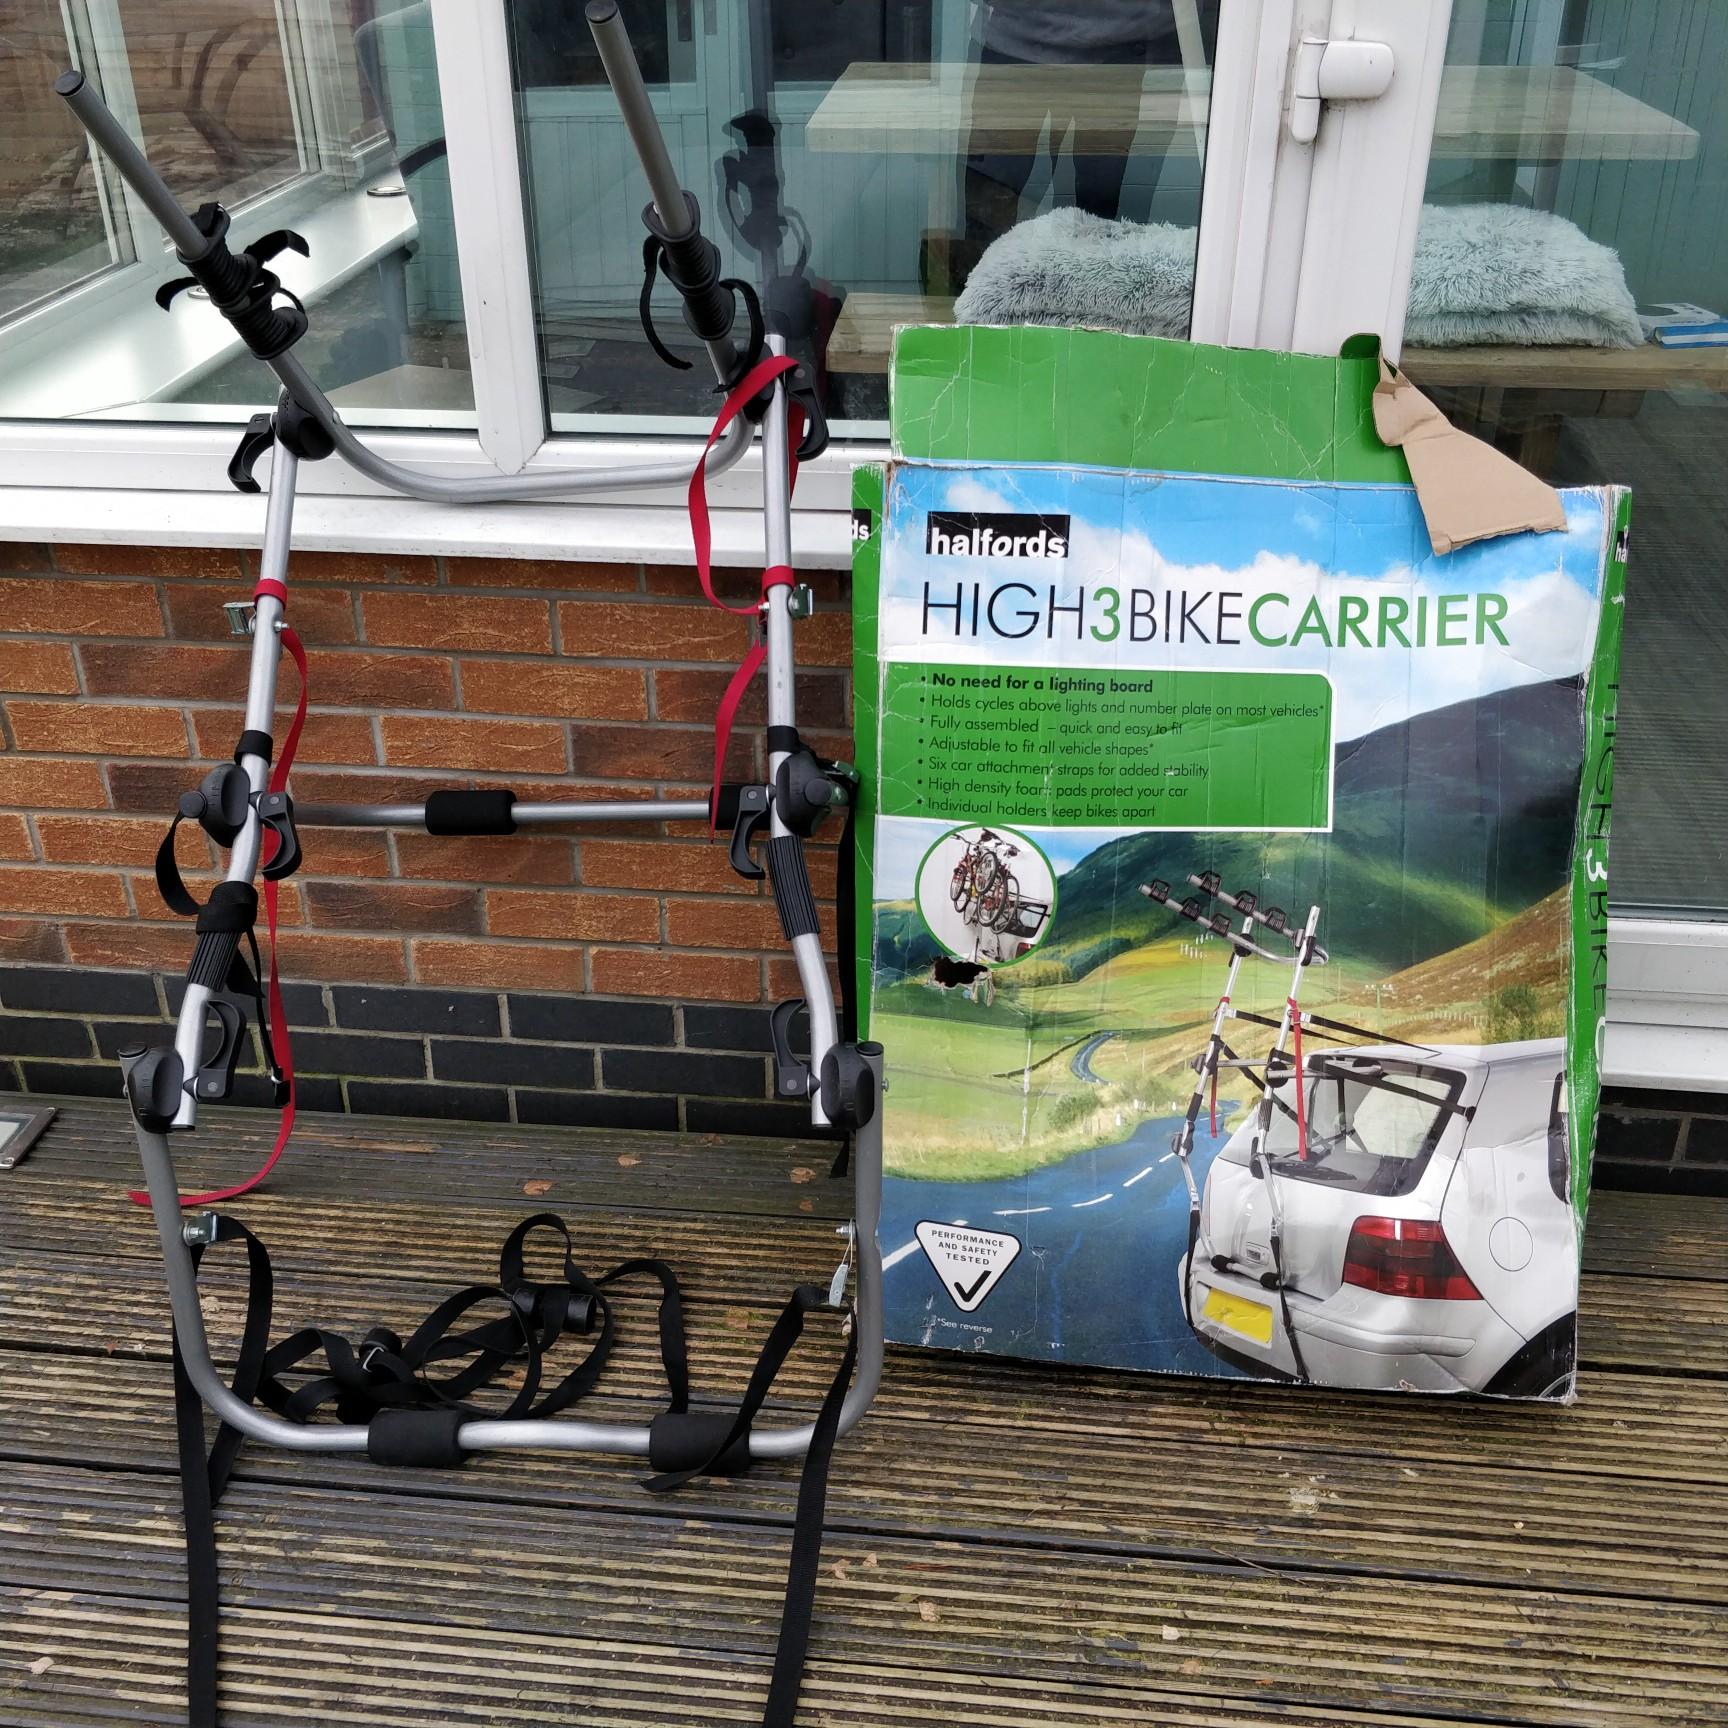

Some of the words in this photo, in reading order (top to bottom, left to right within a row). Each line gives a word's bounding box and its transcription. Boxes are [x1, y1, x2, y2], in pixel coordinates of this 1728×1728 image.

[931, 526, 1067, 558] halfords
[932, 673, 956, 687] No
[961, 675, 1001, 689] need
[1006, 675, 1028, 690] for
[1033, 679, 1044, 690] a
[1050, 676, 1105, 695] lighting
[1110, 678, 1153, 693] board
[931, 694, 970, 709] Holds
[975, 696, 1014, 712] cycles
[1019, 697, 1061, 712] above
[1065, 700, 1097, 715] lights
[1101, 700, 1125, 714] and
[1129, 701, 1177, 715] number
[1182, 702, 1212, 719] plate
[1216, 706, 1232, 716] on
[1236, 704, 1266, 716] most
[930, 715, 960, 731] Fully
[965, 718, 1039, 733] assembled
[1059, 721, 1092, 736] quick
[1097, 721, 1121, 735] and
[1124, 724, 1152, 738] easy
[1156, 725, 1168, 735] to
[1171, 721, 1183, 735] fit
[929, 737, 1000, 752] Adjustable
[1005, 742, 1018, 753] to
[1023, 739, 1035, 753] fit
[1039, 740, 1055, 754] all
[1059, 741, 1101, 755] vehicle
[928, 756, 947, 770] Six
[951, 761, 973, 771] car
[977, 760, 1053, 775] attachment
[1057, 764, 1094, 777] straps
[1098, 762, 1114, 776] for
[1119, 764, 1159, 776] added
[1163, 764, 1209, 780] stability
[928, 777, 960, 793] High
[965, 779, 1011, 796] density
[1056, 784, 1087, 799] pads
[1091, 785, 1133, 799] protect
[1137, 788, 1165, 800] your
[1168, 787, 1189, 797] car
[928, 797, 992, 814] Individual
[997, 799, 1047, 817] holders
[1052, 803, 1082, 820] keep
[1086, 804, 1118, 818] bikes
[1122, 806, 1156, 820] apart
[931, 1229, 1004, 1248] PERFORMANCE
[938, 1241, 958, 1250] AND
[961, 1245, 998, 1257] SAFETY
[946, 1252, 990, 1265] TESTED
[960, 1322, 993, 1333] reverse
